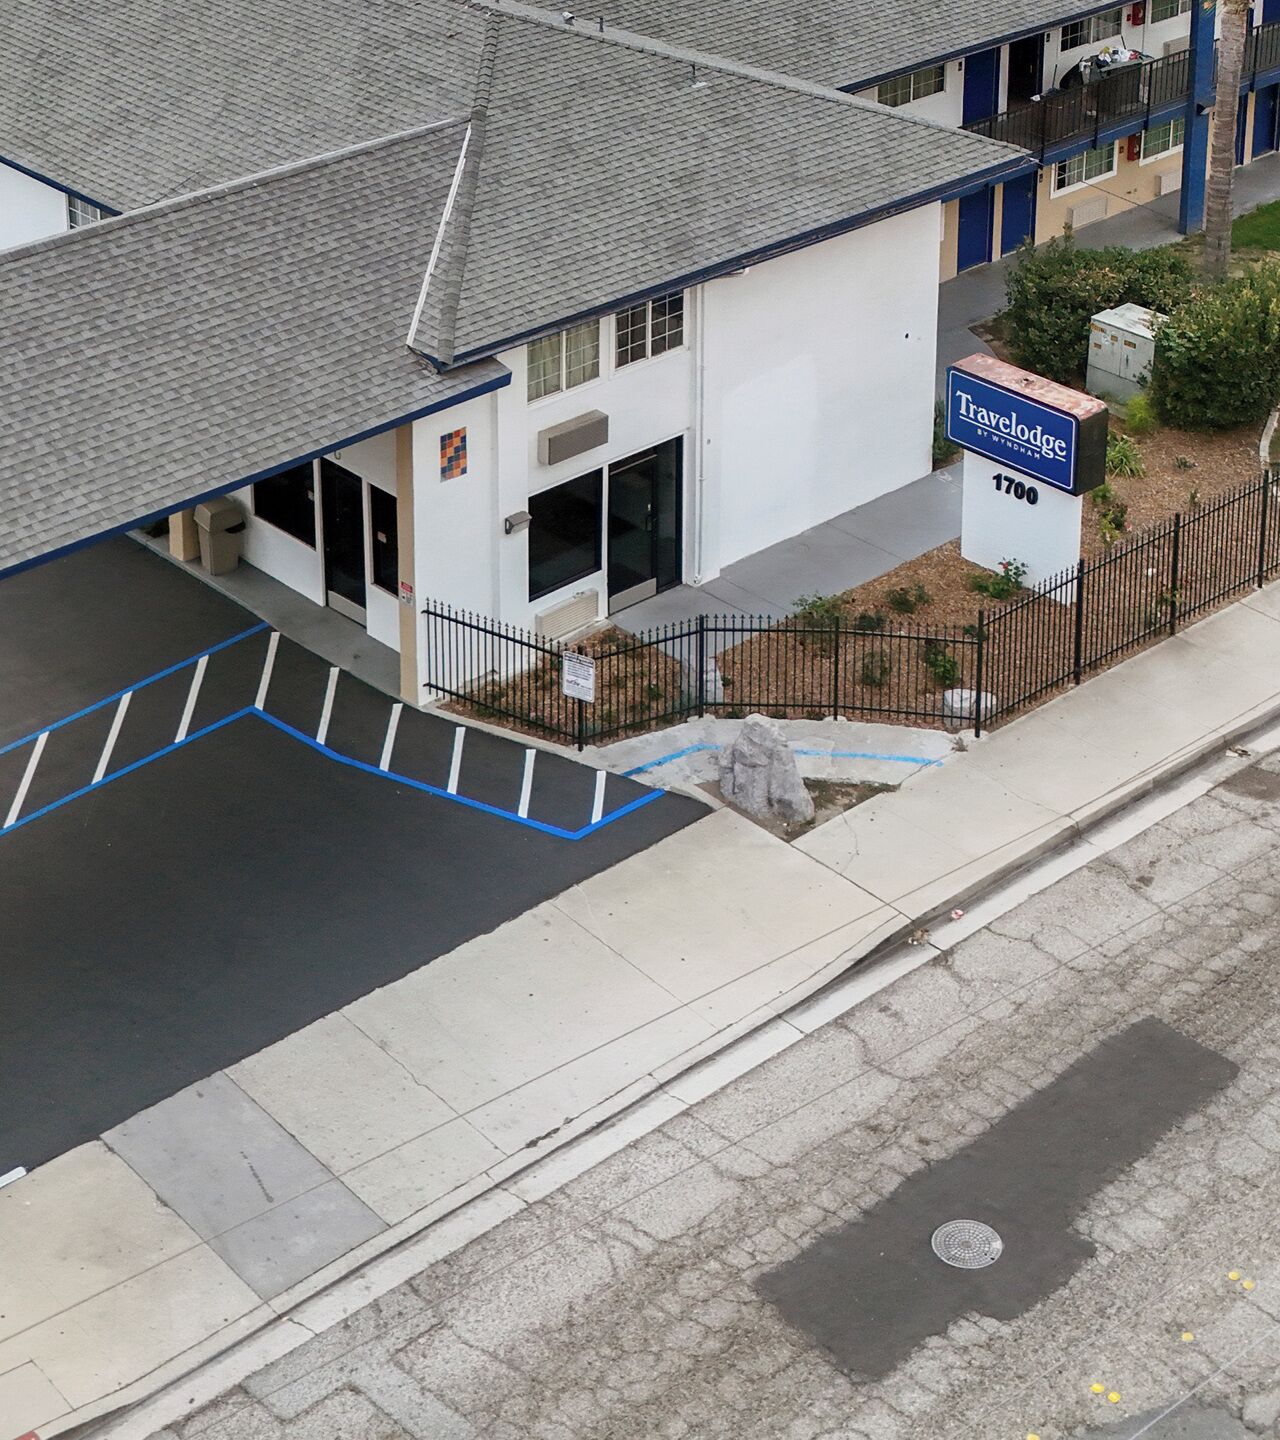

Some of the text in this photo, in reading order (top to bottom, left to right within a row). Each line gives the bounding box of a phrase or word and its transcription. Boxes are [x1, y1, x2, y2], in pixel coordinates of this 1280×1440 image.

[955, 390, 1067, 459] Travelodge
[977, 428, 1041, 460] BY WYNDHAM
[992, 472, 1039, 505] 1700
